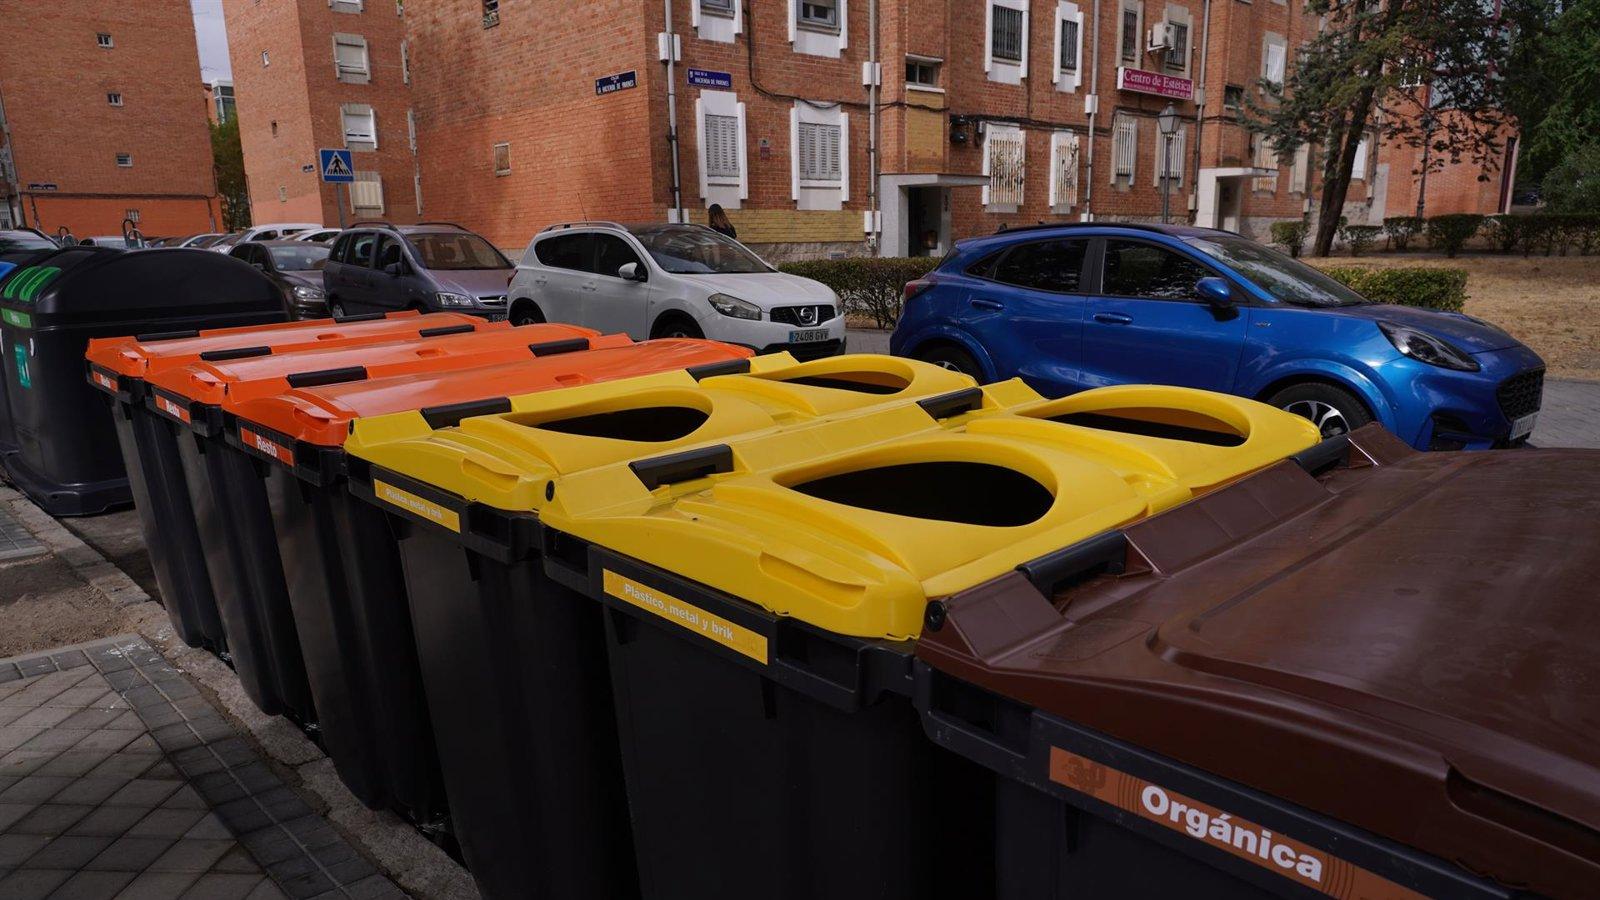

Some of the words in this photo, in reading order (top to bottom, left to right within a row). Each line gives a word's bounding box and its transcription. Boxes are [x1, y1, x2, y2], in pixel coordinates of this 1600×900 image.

[1124, 69, 1151, 84] Centro
[1152, 75, 1161, 86] de
[1163, 76, 1191, 92] Estética
[256, 434, 277, 458] Resto
[669, 603, 699, 625] metal
[702, 620, 709, 631] y
[711, 621, 733, 640] brik
[1141, 785, 1323, 883] Orgánica
